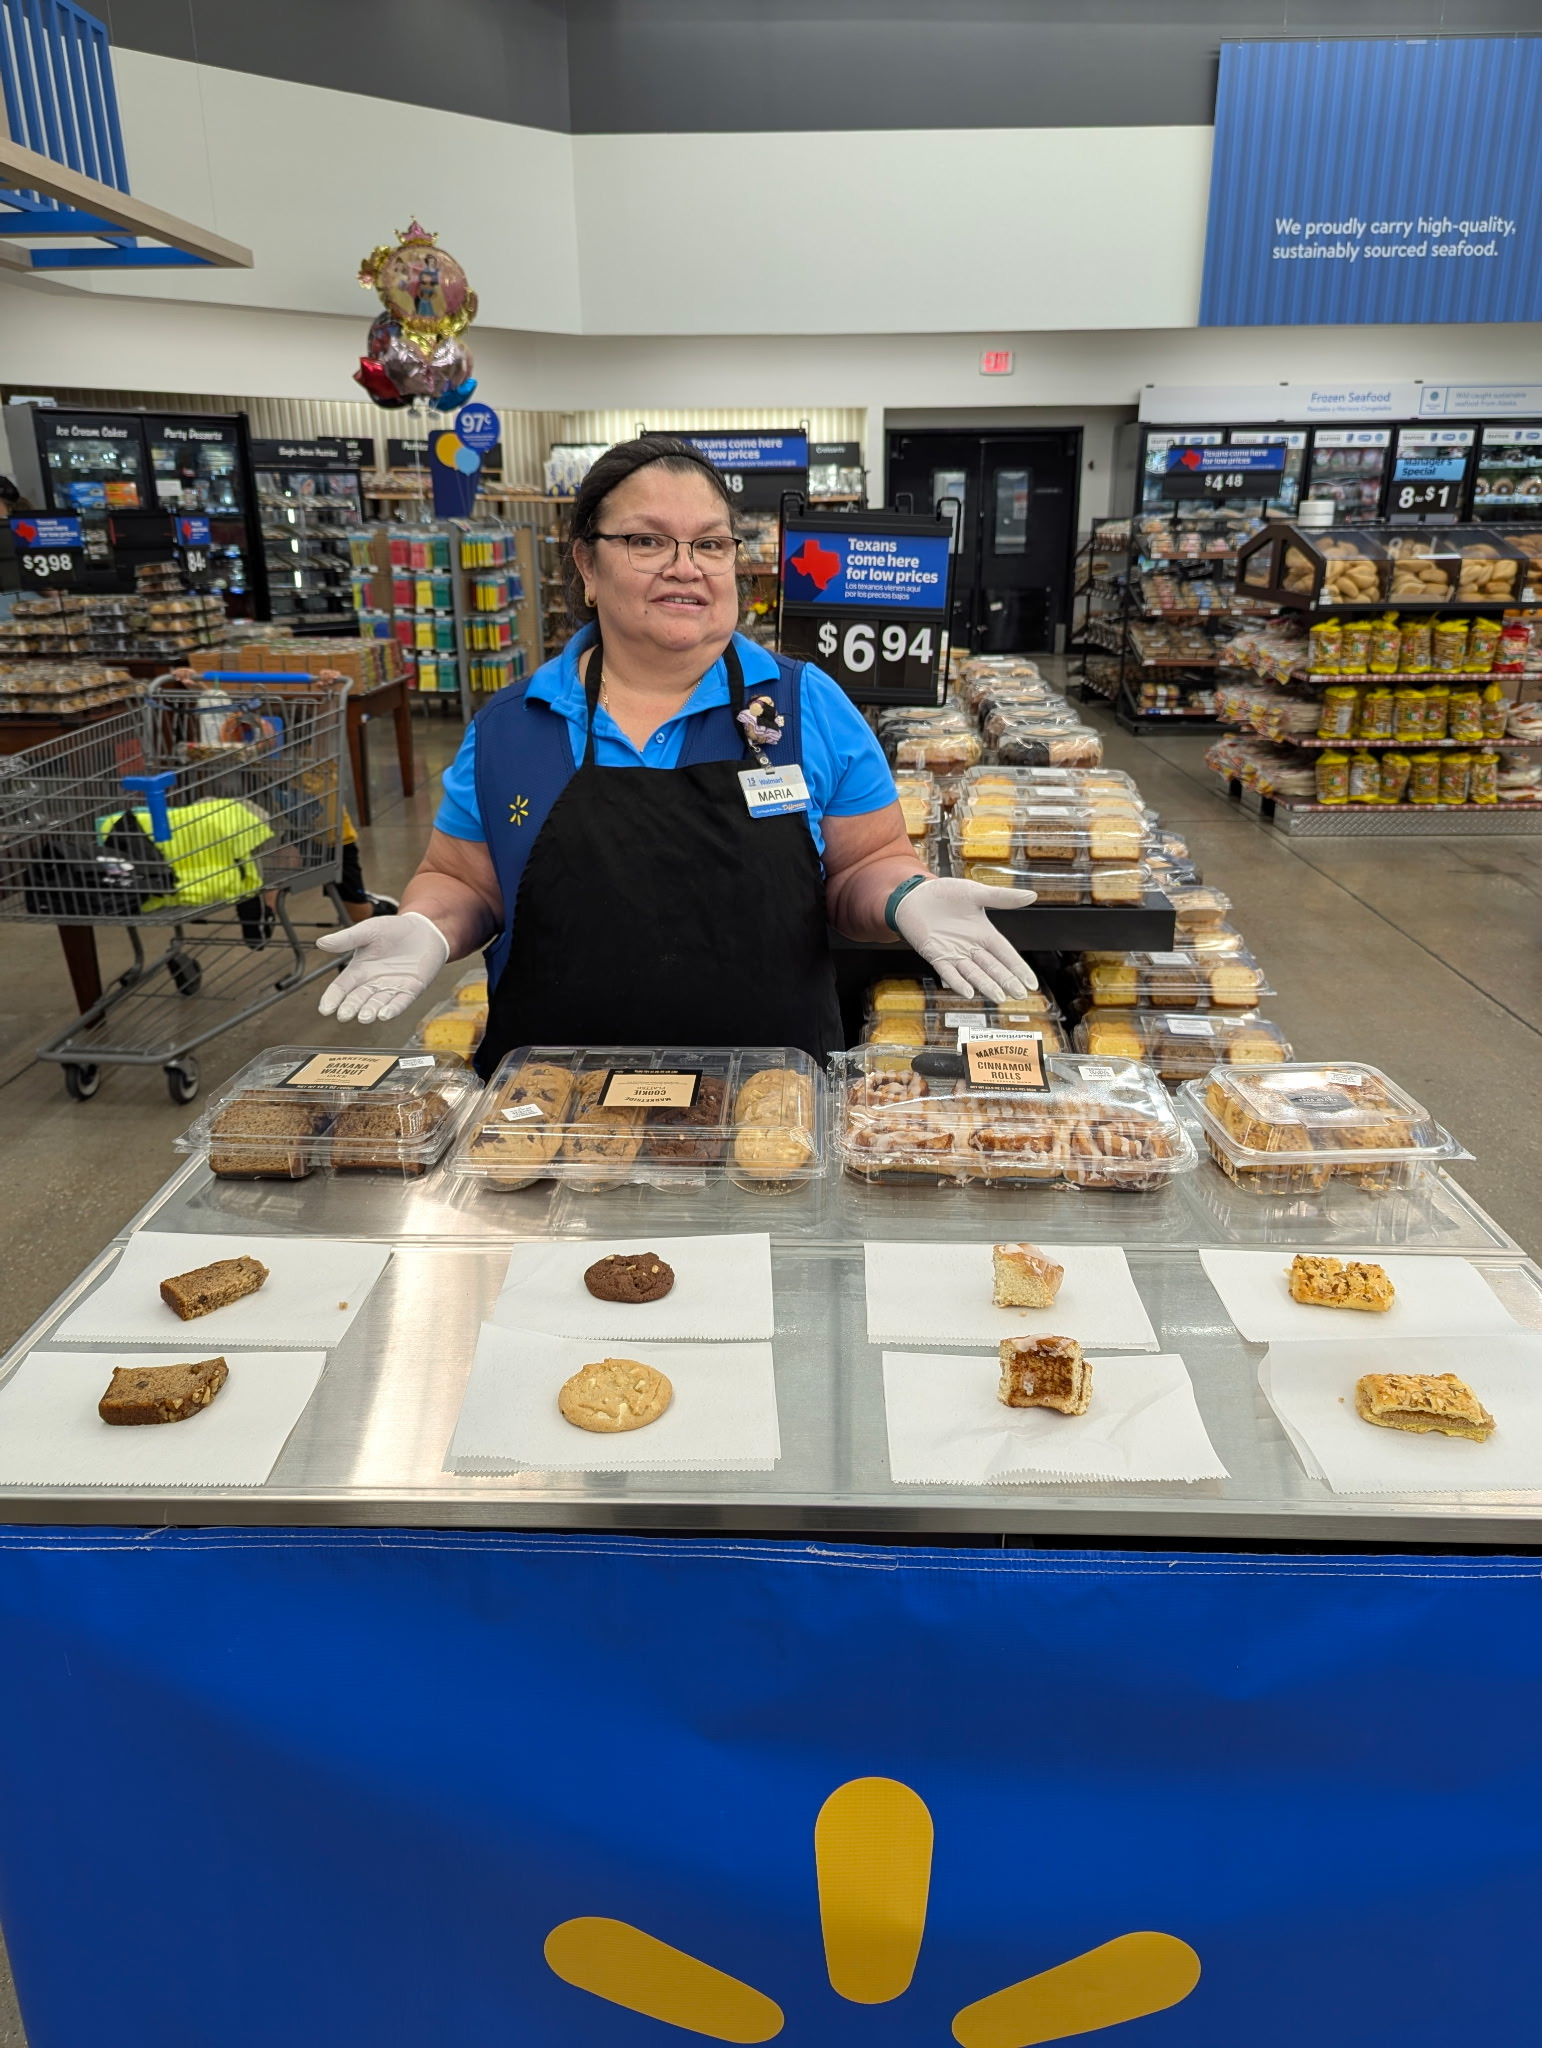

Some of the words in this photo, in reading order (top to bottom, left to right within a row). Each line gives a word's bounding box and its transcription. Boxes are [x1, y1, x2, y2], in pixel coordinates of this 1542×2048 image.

[1275, 217, 1301, 235] We
[1304, 217, 1367, 240] proudly
[1370, 220, 1414, 239] carry
[1417, 216, 1517, 238] high-quality,
[1272, 242, 1360, 262] sustainably
[1363, 240, 1428, 258] sourced
[1431, 240, 1499, 257] seafood.
[1310, 391, 1345, 403] Frozen
[1348, 391, 1392, 403] Seafood
[56, 425, 69, 437] Ice
[164, 427, 187, 441] Party
[691, 438, 728, 450] Texans
[728, 439, 757, 449] come
[757, 438, 783, 449] here
[708, 449, 727, 460] low
[728, 449, 760, 461] prices
[1402, 467, 1436, 477] Special
[1398, 486, 1415, 509] 8
[848, 537, 897, 553] Texans
[847, 554, 886, 567] come
[887, 554, 920, 568] here
[846, 568, 869, 581] for
[869, 568, 894, 582] low
[895, 570, 938, 585] prices
[845, 582, 857, 590] Los
[857, 583, 883, 591] texanos
[883, 584, 906, 592] vienen
[844, 591, 857, 599] por
[857, 590, 867, 598] los
[867, 591, 892, 600] precios
[892, 592, 910, 601] bajos
[746, 777, 756, 785] 15
[758, 776, 783, 786] Walmart
[757, 788, 794, 802] MARIA
[975, 1045, 1029, 1059] MARKETSIDE
[320, 1068, 365, 1076] WALNUT
[325, 1062, 369, 1070] BANANA
[977, 1061, 1032, 1072] CINNAMON
[991, 1071, 1021, 1081] ROLLS
